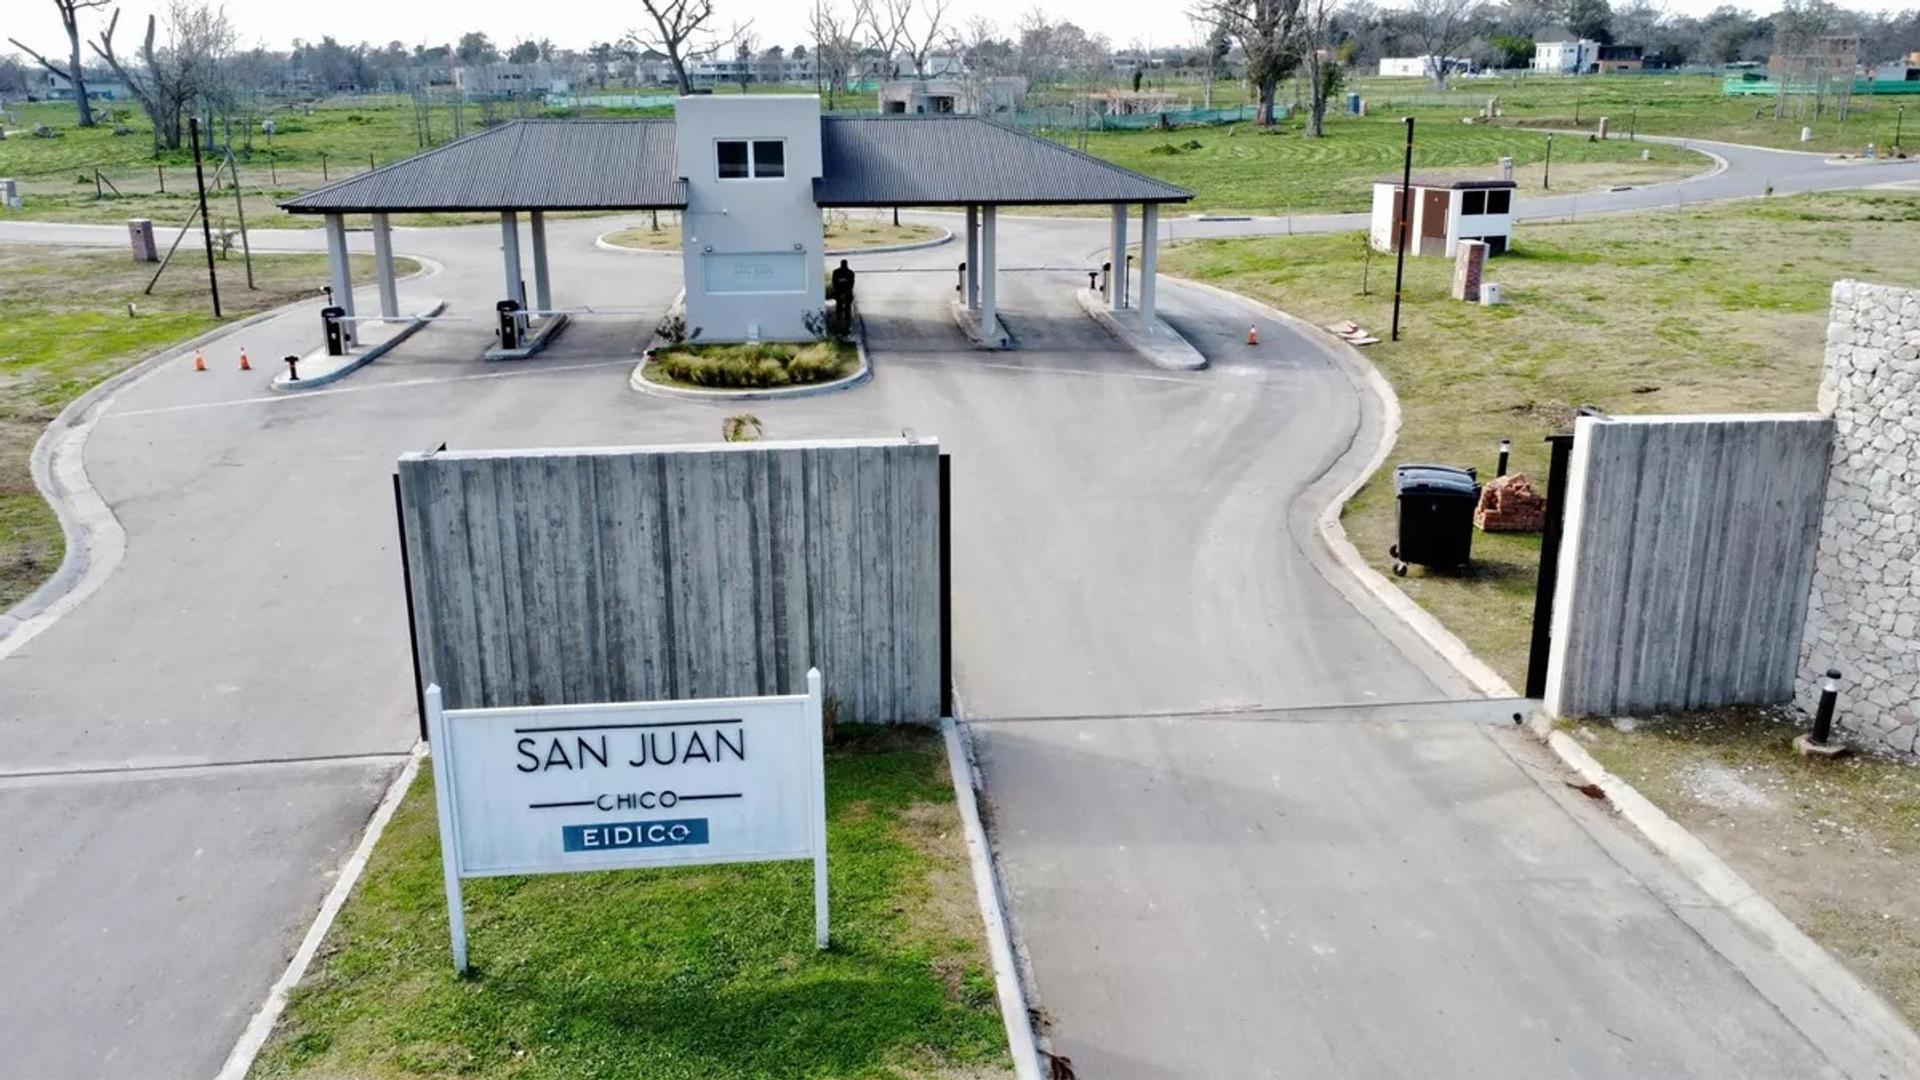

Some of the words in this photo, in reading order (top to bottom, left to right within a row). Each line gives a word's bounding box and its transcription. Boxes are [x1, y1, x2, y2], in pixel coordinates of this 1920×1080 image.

[515, 735, 609, 773] SAN
[628, 728, 745, 768] JUAN
[596, 791, 678, 811] CHICO
[583, 824, 690, 847] EIDICO
